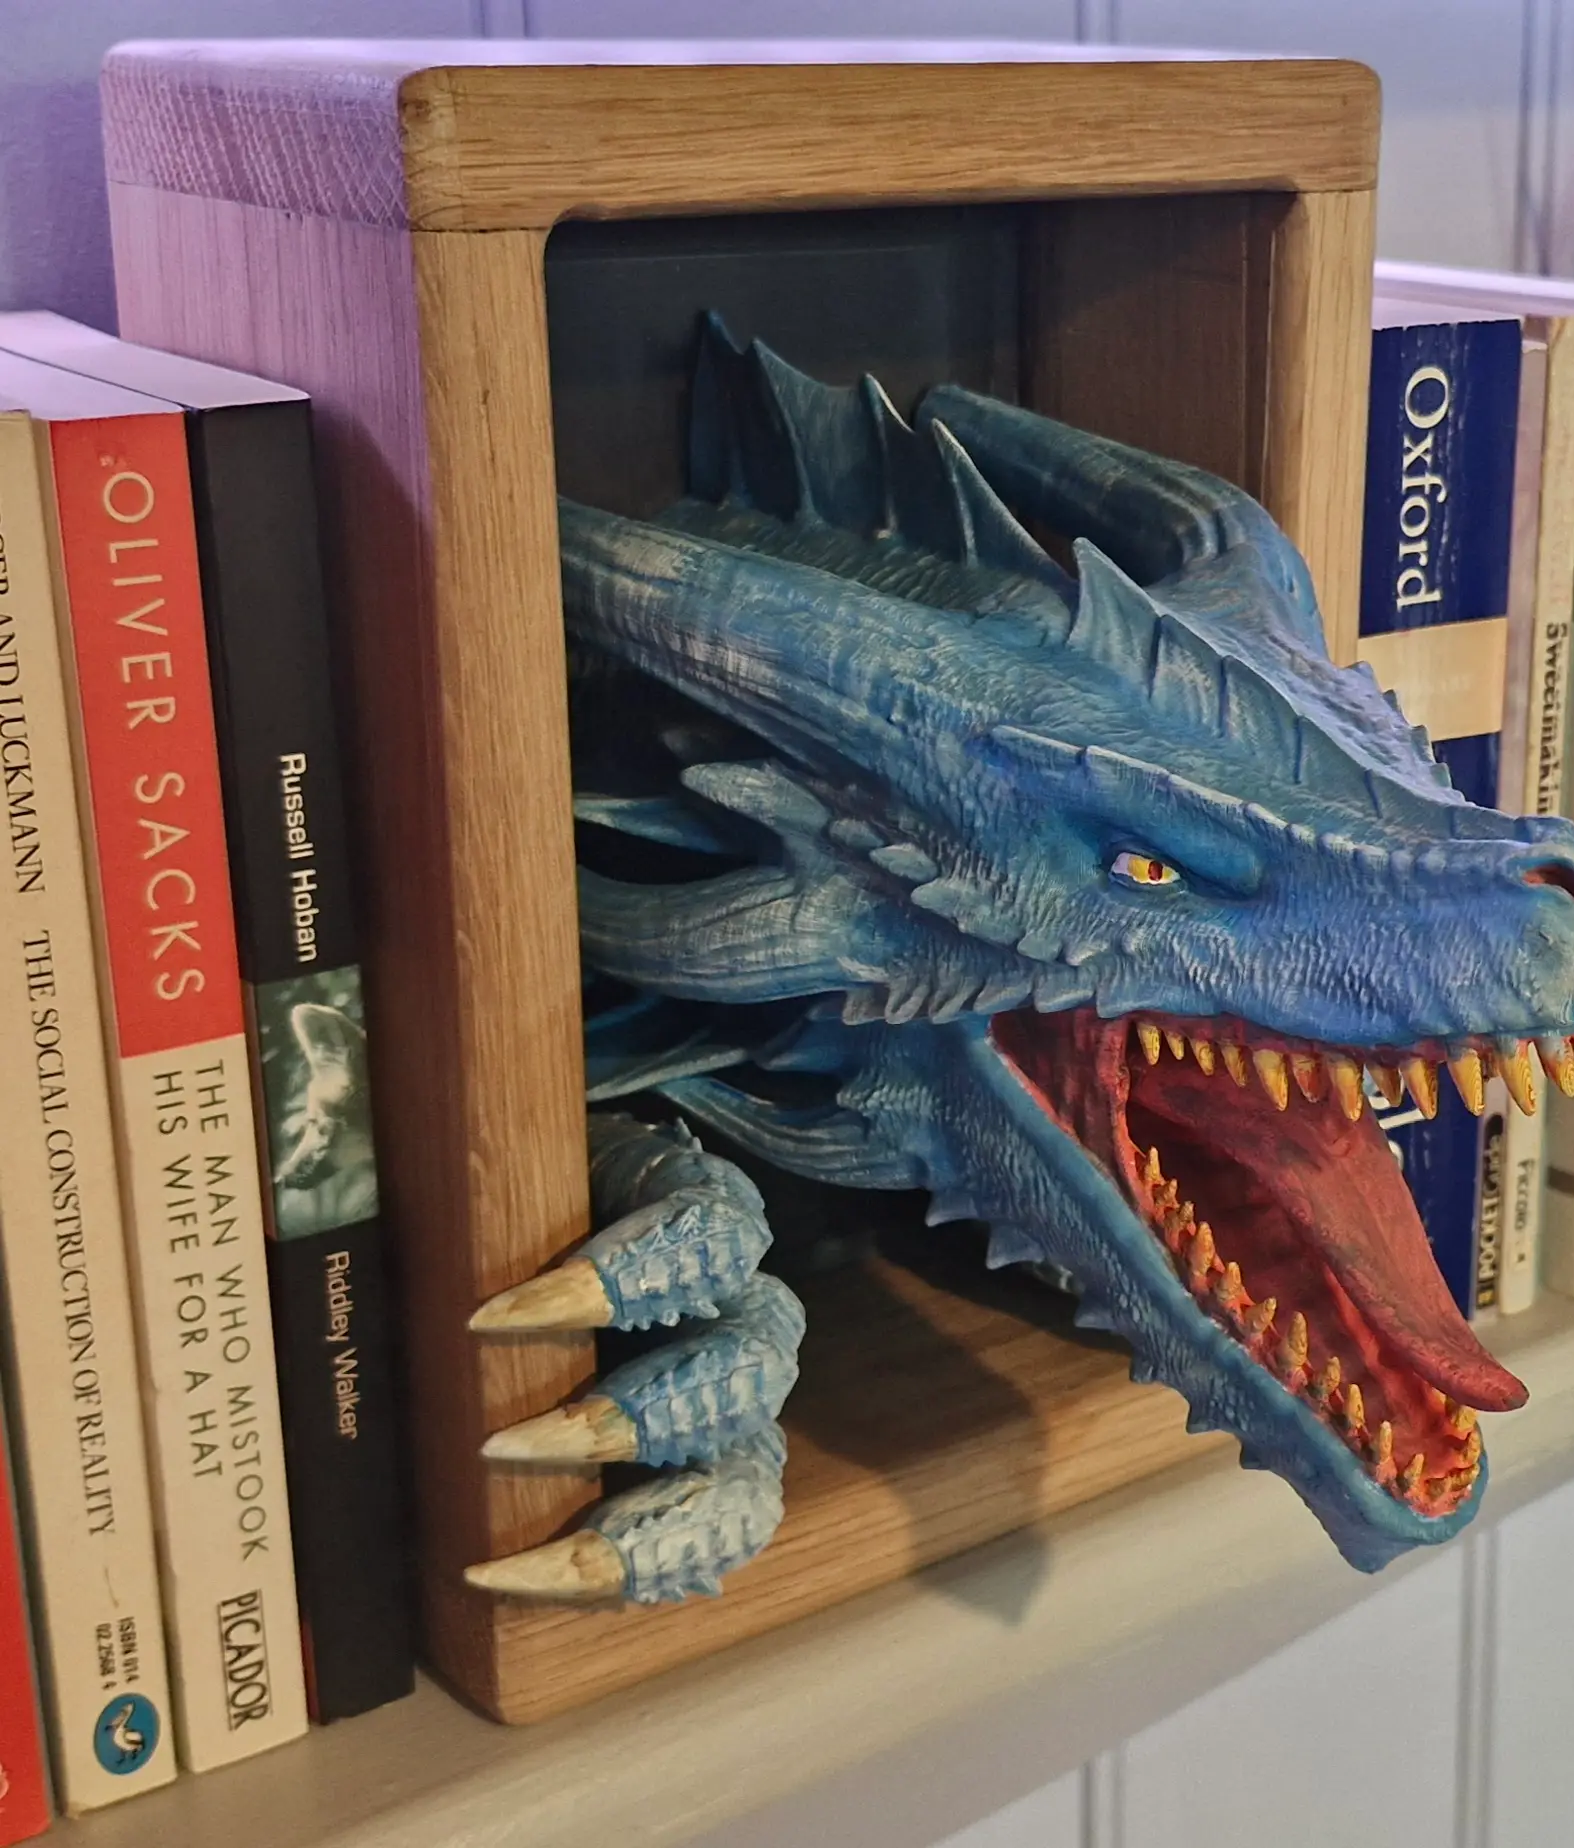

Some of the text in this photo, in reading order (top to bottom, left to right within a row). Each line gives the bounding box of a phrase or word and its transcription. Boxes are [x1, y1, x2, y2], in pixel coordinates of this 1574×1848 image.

[1396, 365, 1449, 613] Oxford
[0, 695, 46, 894] LUCKMANN
[103, 471, 206, 1001] OLIVER SACKS
[1536, 622, 1568, 815] Sweetmakin
[279, 752, 320, 963] Russell Hoban
[23, 928, 116, 1538] THE SOCIAL CONSTRUCTION OF REALITY
[152, 1069, 223, 1479] HIS WIFE FOR A HAT
[195, 1058, 270, 1561] THE MAN WHO MISTOOK
[325, 1250, 361, 1440] Riddley Walker
[118, 1616, 139, 1656] ISBN
[219, 1590, 271, 1732] PICADOR
